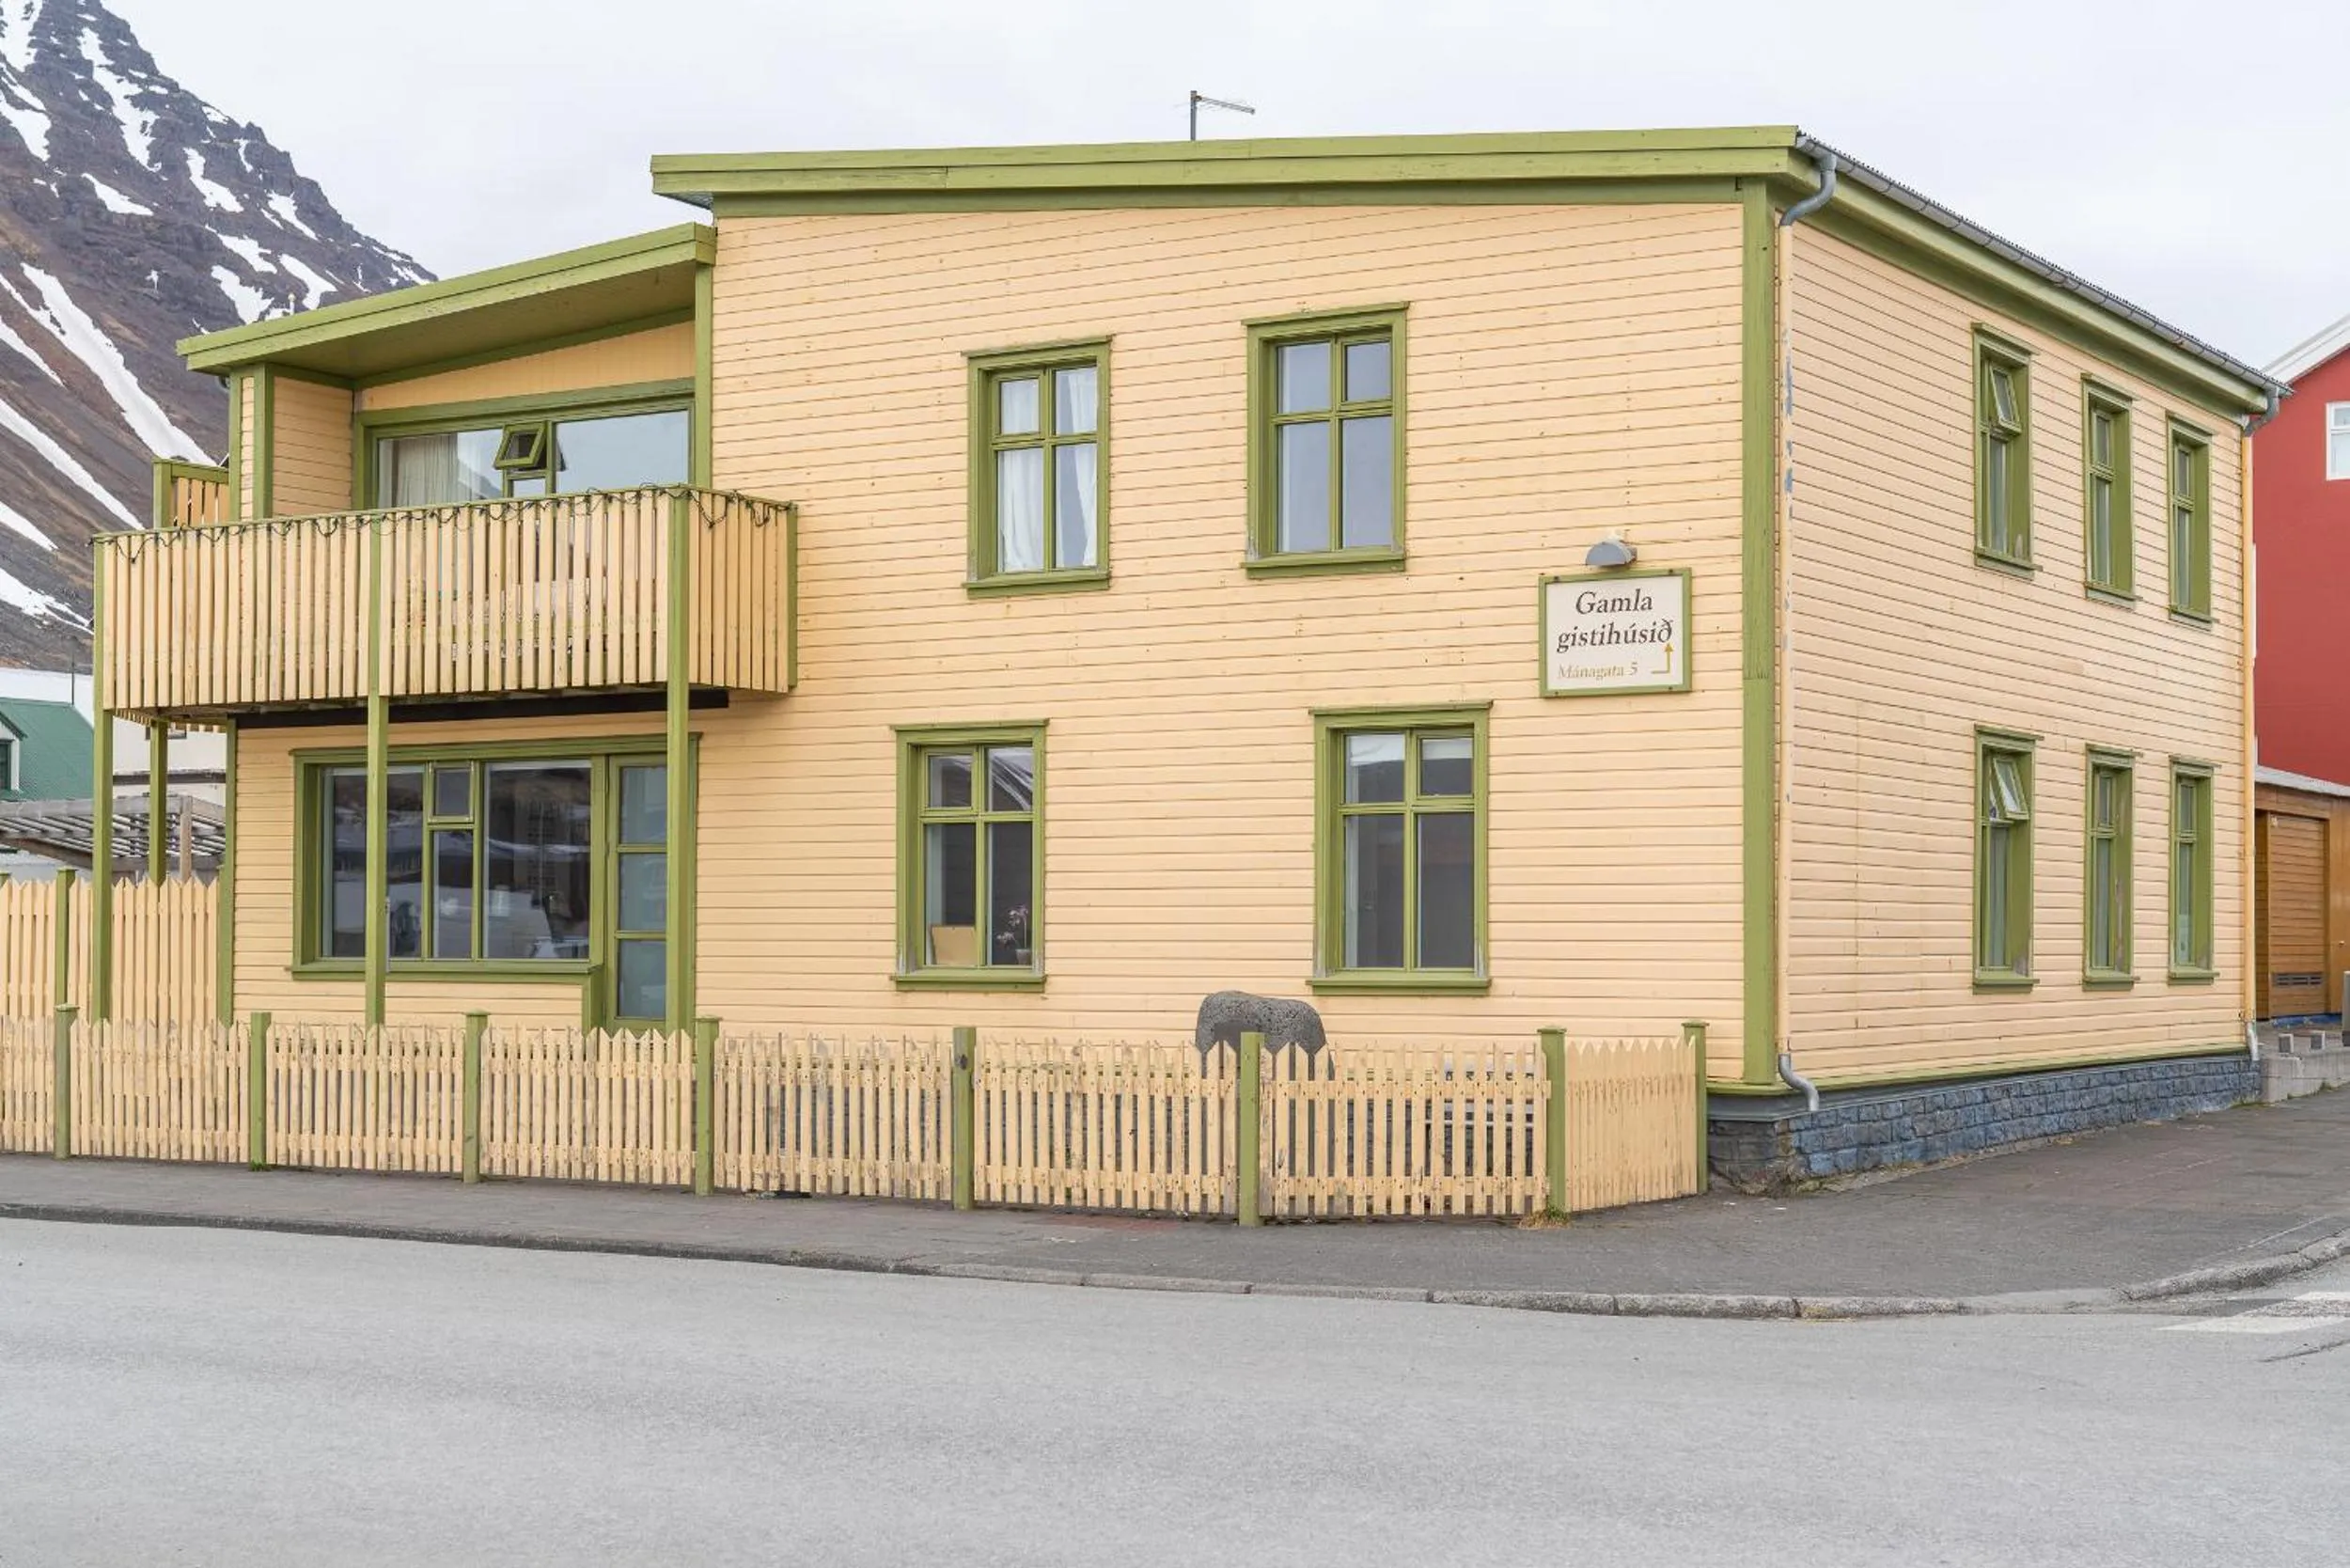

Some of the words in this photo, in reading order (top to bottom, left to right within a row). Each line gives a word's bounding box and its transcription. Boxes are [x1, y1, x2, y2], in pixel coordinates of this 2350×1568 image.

[1575, 588, 1653, 615] Gamla
[1556, 619, 1674, 653] gistihúsið
[1557, 664, 1625, 681] Mánagata
[1628, 662, 1638, 676] 5
